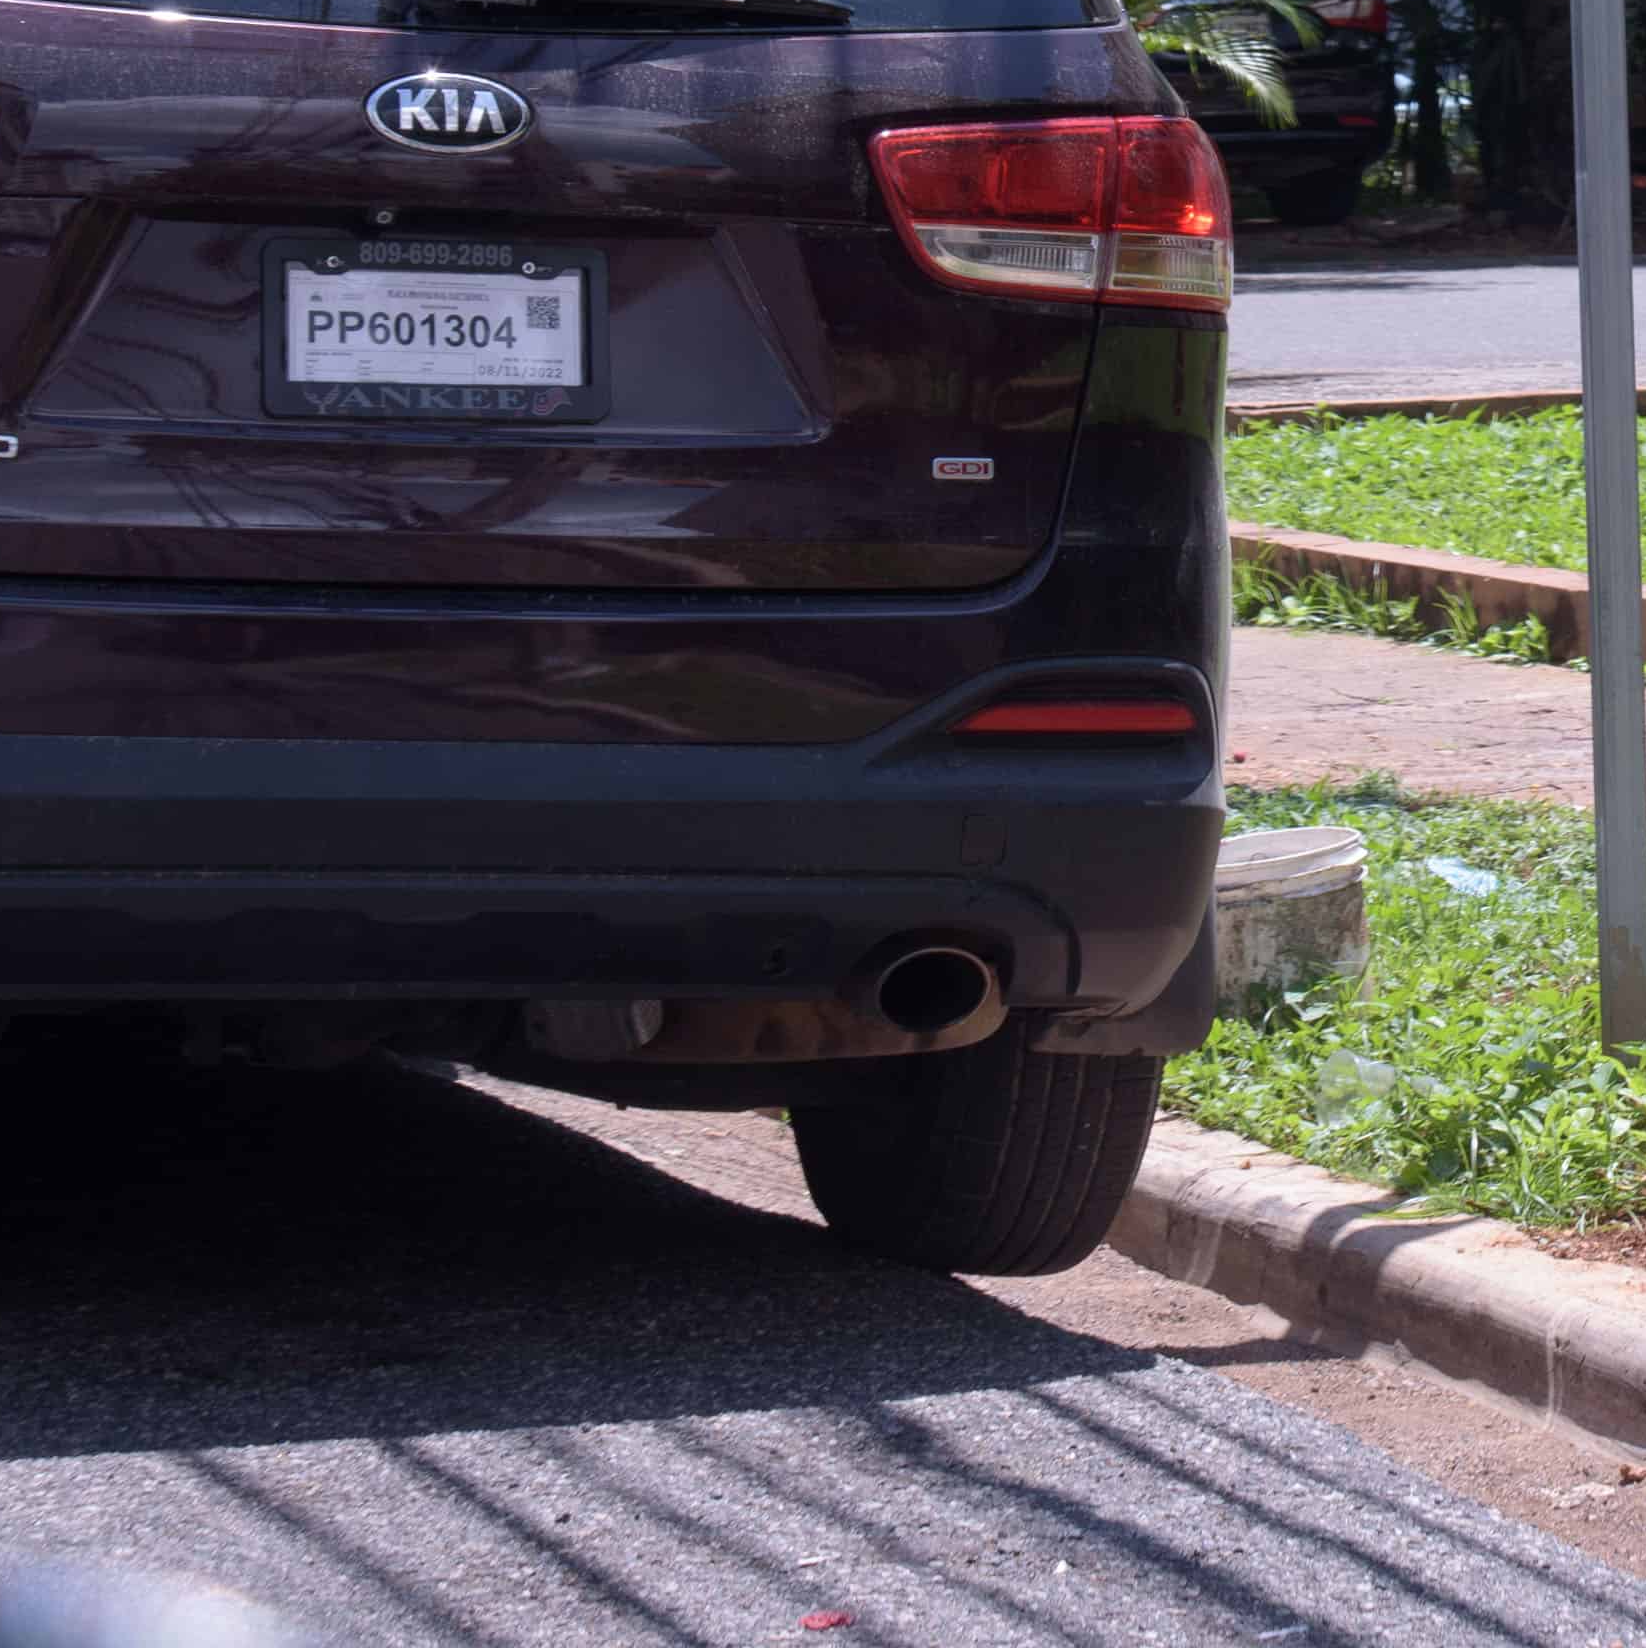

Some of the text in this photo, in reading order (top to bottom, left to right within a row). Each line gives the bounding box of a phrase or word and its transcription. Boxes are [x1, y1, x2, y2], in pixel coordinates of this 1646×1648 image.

[395, 87, 508, 136] KIA
[358, 241, 514, 267] 809-699-2896
[306, 309, 518, 350] PP601304
[303, 385, 528, 415] YANKEE
[938, 462, 990, 474] GDI
